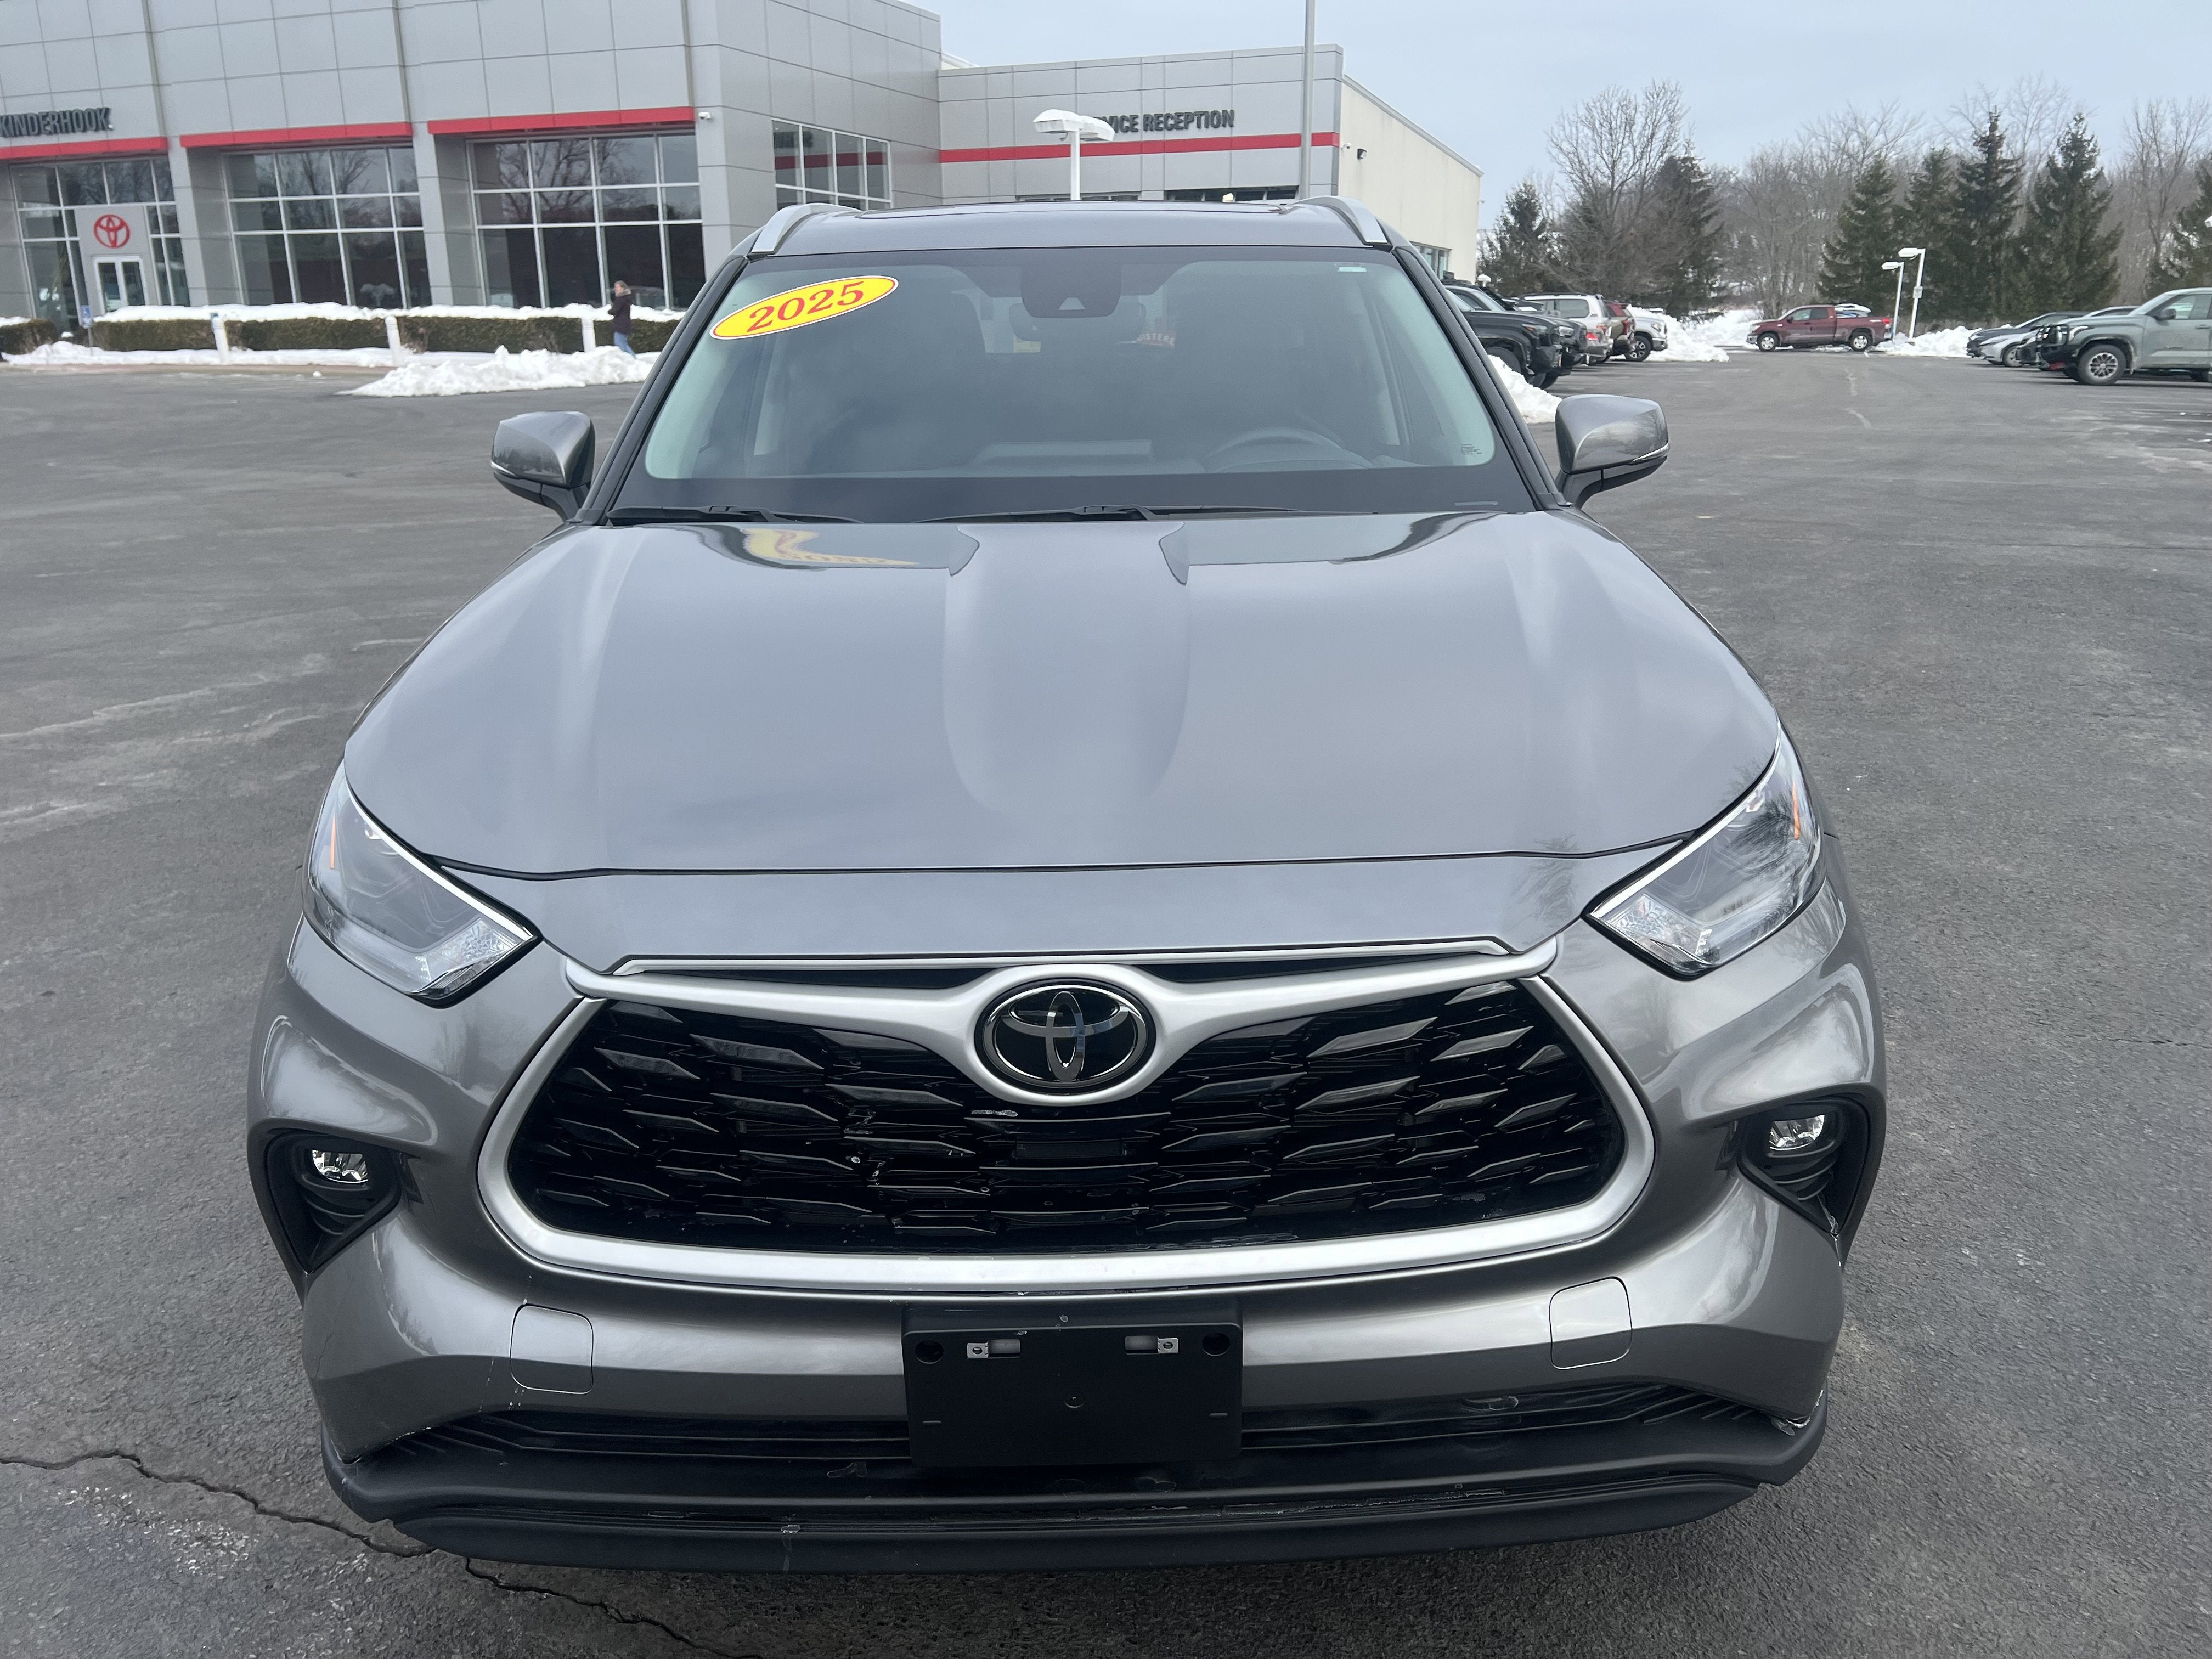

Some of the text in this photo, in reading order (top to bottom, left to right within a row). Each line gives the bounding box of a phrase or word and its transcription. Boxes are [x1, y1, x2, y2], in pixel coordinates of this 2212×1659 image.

[0, 108, 111, 138] KINDERHOOK
[1143, 109, 1234, 131] RECEPTION
[747, 281, 864, 332] 2025
